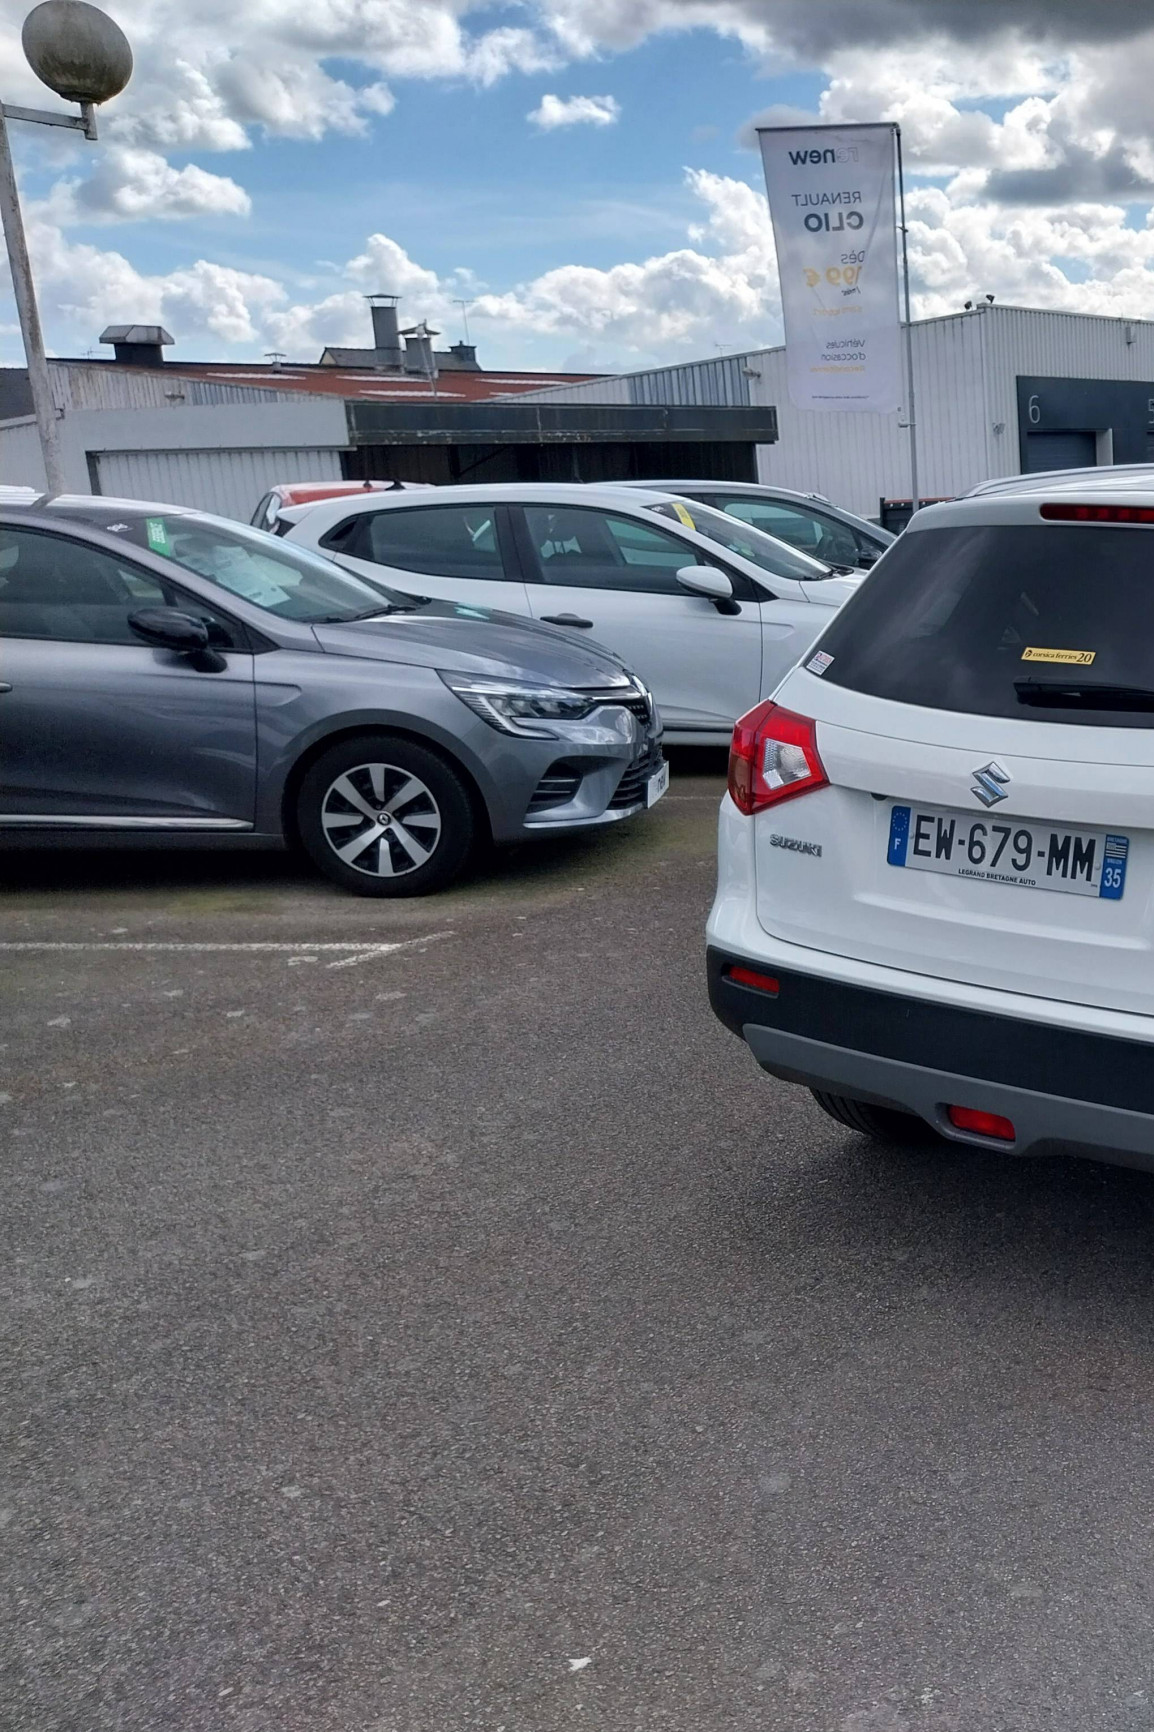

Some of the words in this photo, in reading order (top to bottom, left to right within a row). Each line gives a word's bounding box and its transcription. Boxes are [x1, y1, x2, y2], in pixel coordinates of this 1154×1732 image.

[1028, 394, 1041, 424] 6
[1032, 651, 1055, 659] corsica
[1055, 652, 1077, 660] ferries
[1076, 652, 1093, 663] 20
[769, 833, 823, 858] SUZUKI
[894, 838, 902, 850] F
[913, 814, 1097, 882] EW-679-MM
[957, 868, 986, 879] LEGRAND
[986, 872, 1018, 884] BRETAGNE
[1019, 878, 1037, 887] AUTO
[1104, 867, 1122, 888] 35
